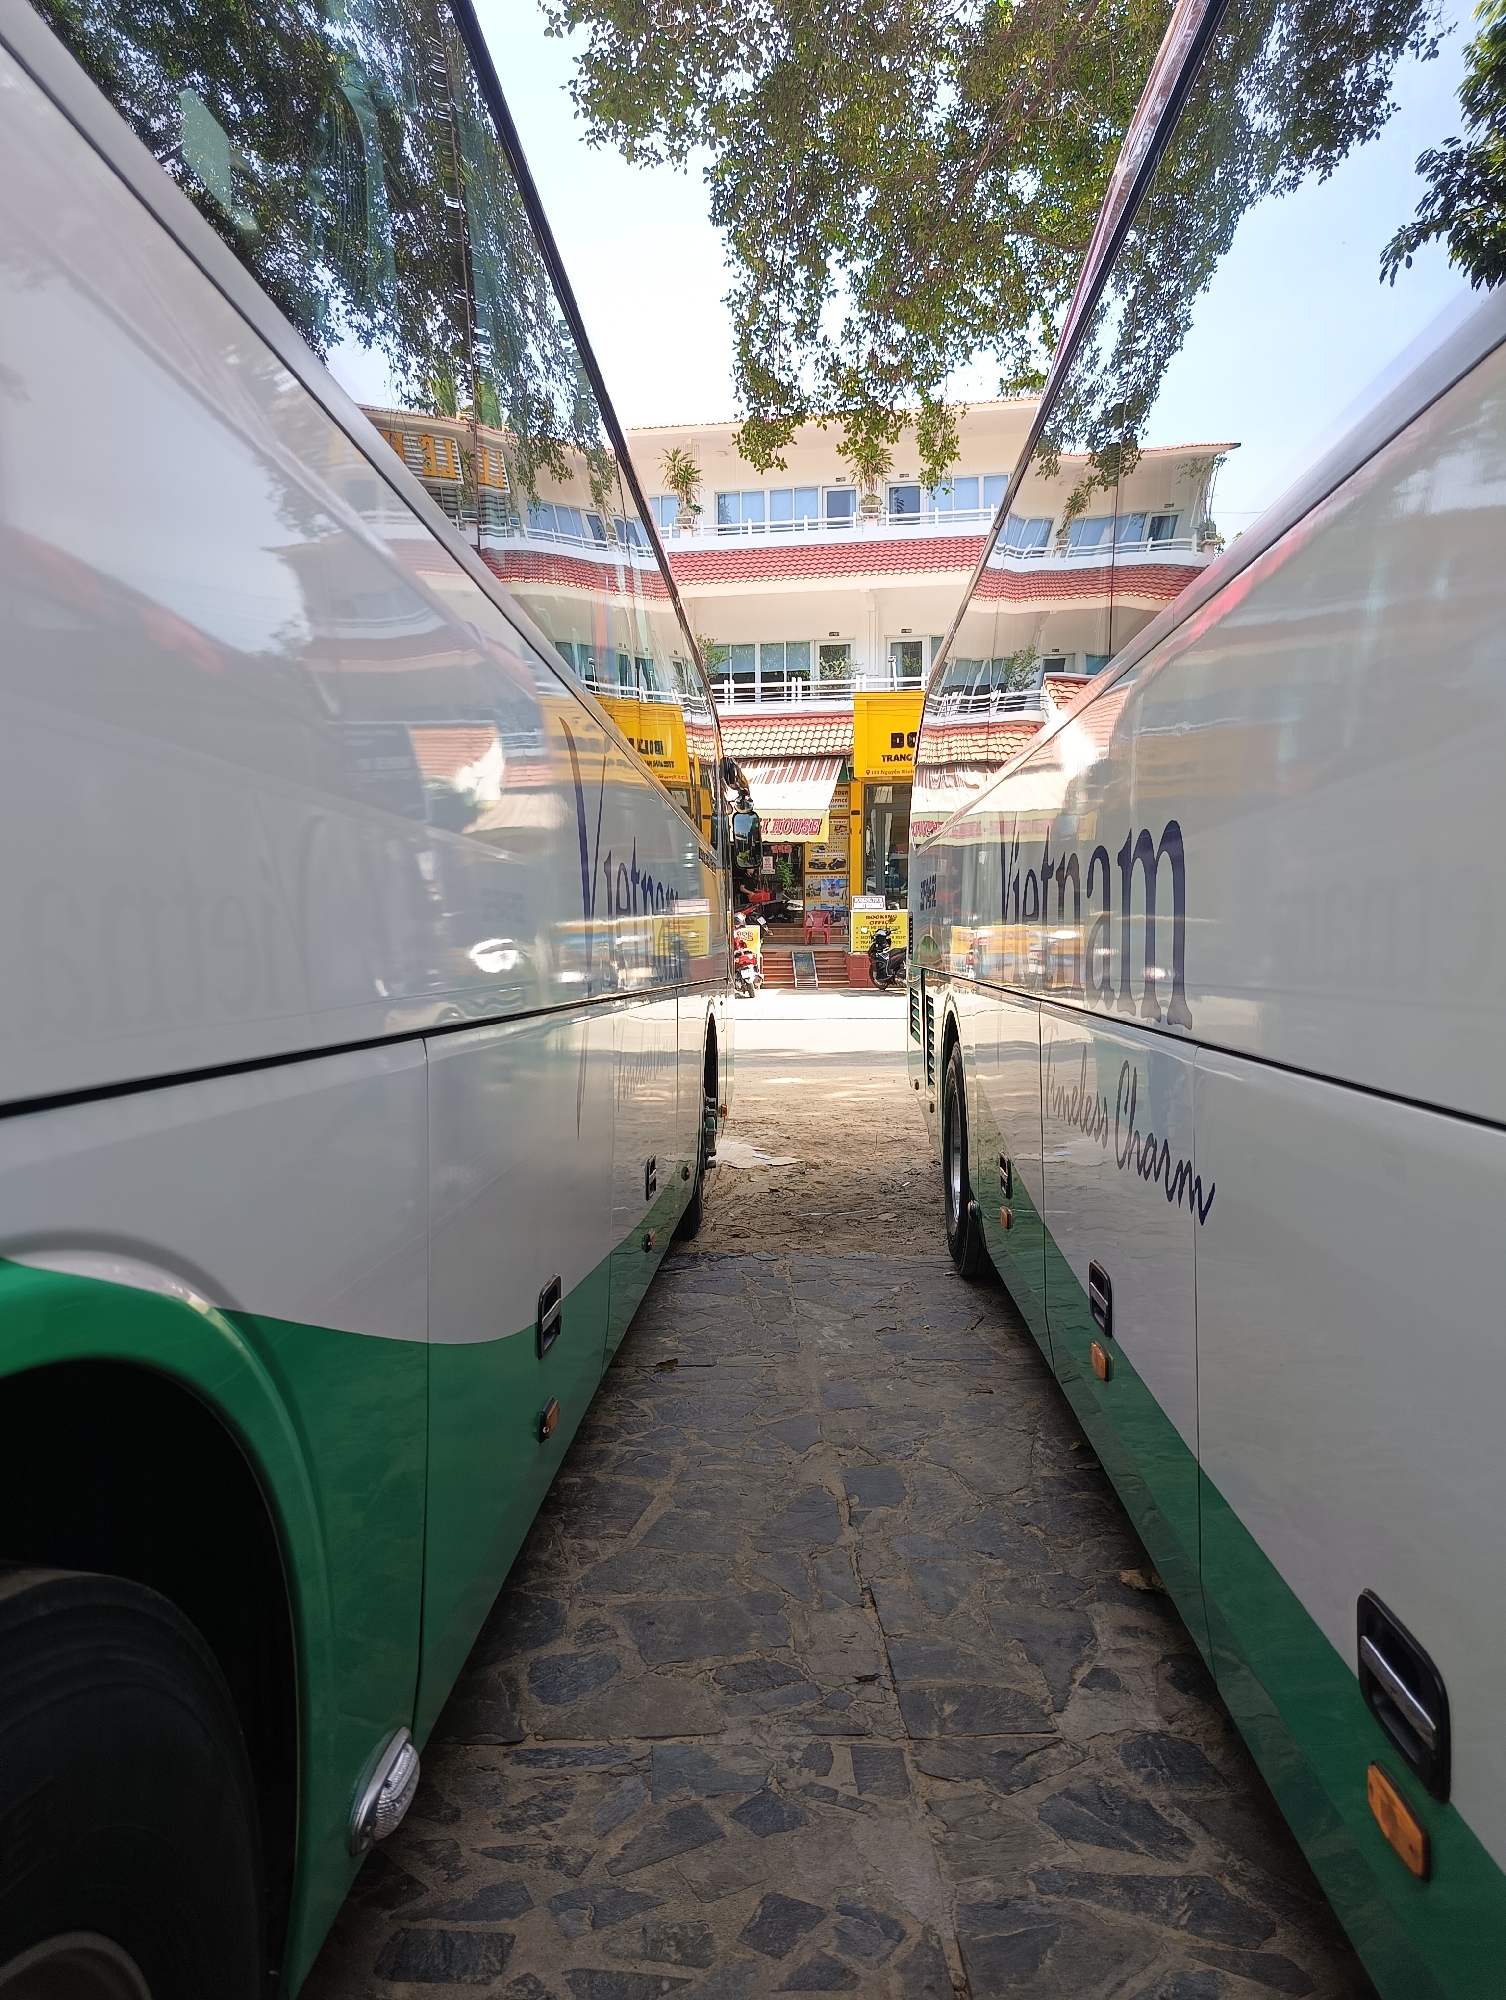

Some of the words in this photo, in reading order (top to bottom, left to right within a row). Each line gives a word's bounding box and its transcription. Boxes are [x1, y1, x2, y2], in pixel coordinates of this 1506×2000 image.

[770, 818, 823, 835] HOUSE
[999, 810, 1193, 1031] Vietnam
[1041, 1019, 1109, 1149] Timeless
[1113, 1060, 1216, 1226] Charm
